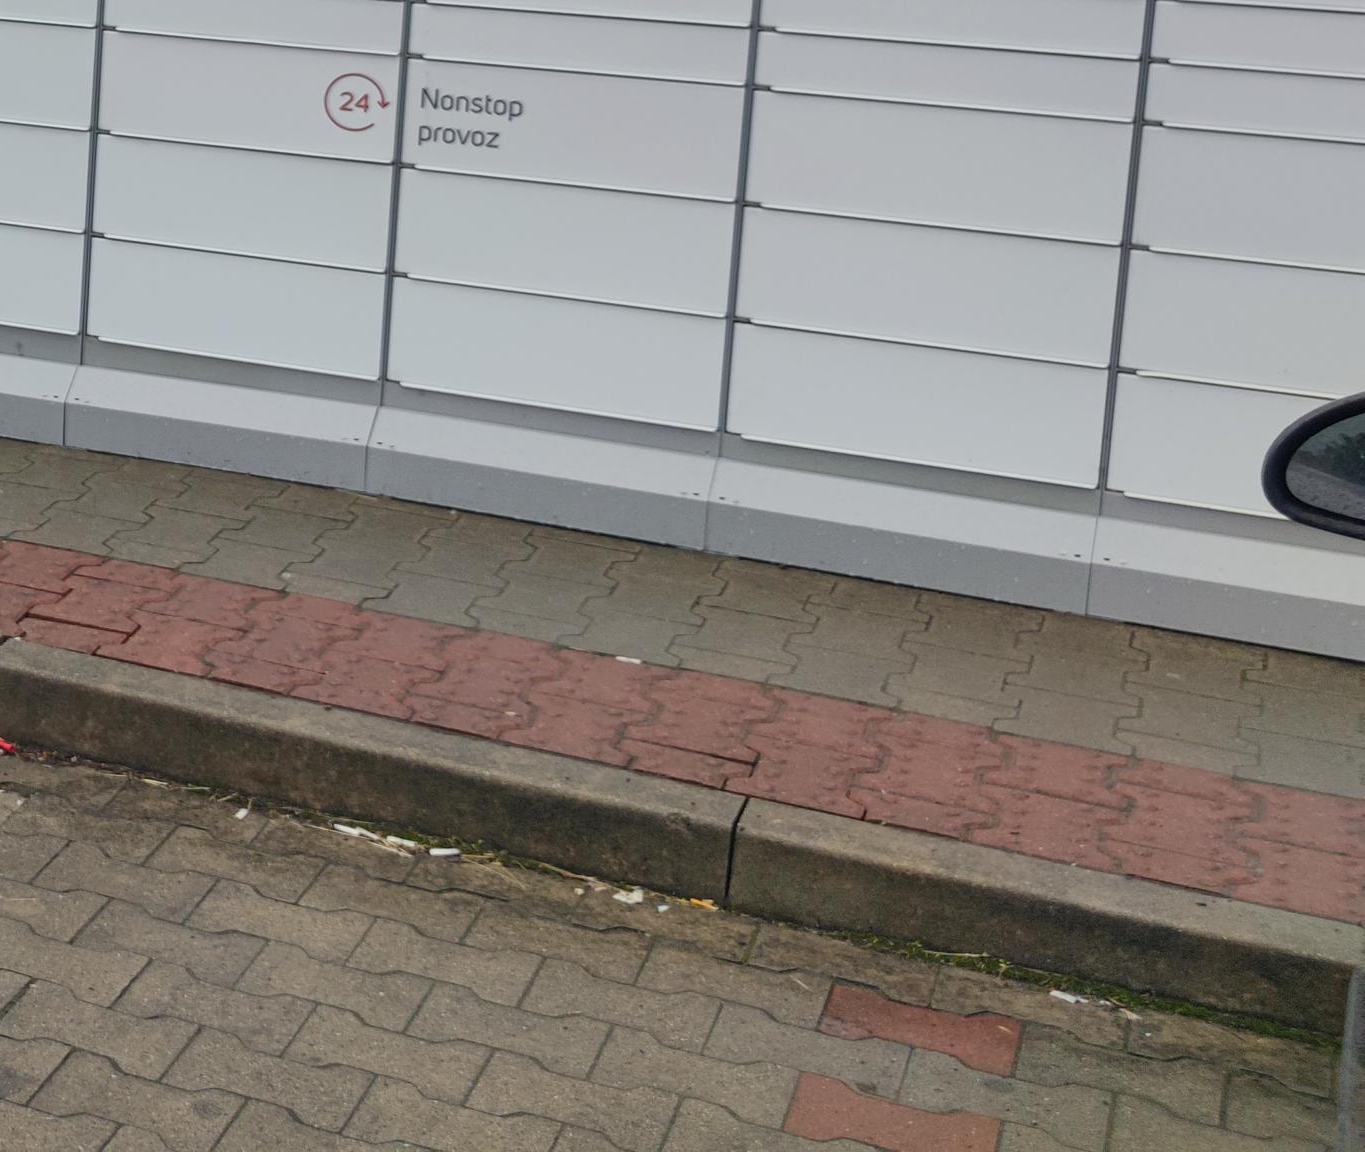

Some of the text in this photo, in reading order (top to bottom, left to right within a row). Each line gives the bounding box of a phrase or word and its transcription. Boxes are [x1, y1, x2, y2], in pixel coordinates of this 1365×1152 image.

[338, 91, 370, 113] 24
[419, 87, 524, 121] Nonstop
[417, 124, 501, 149] provoz
